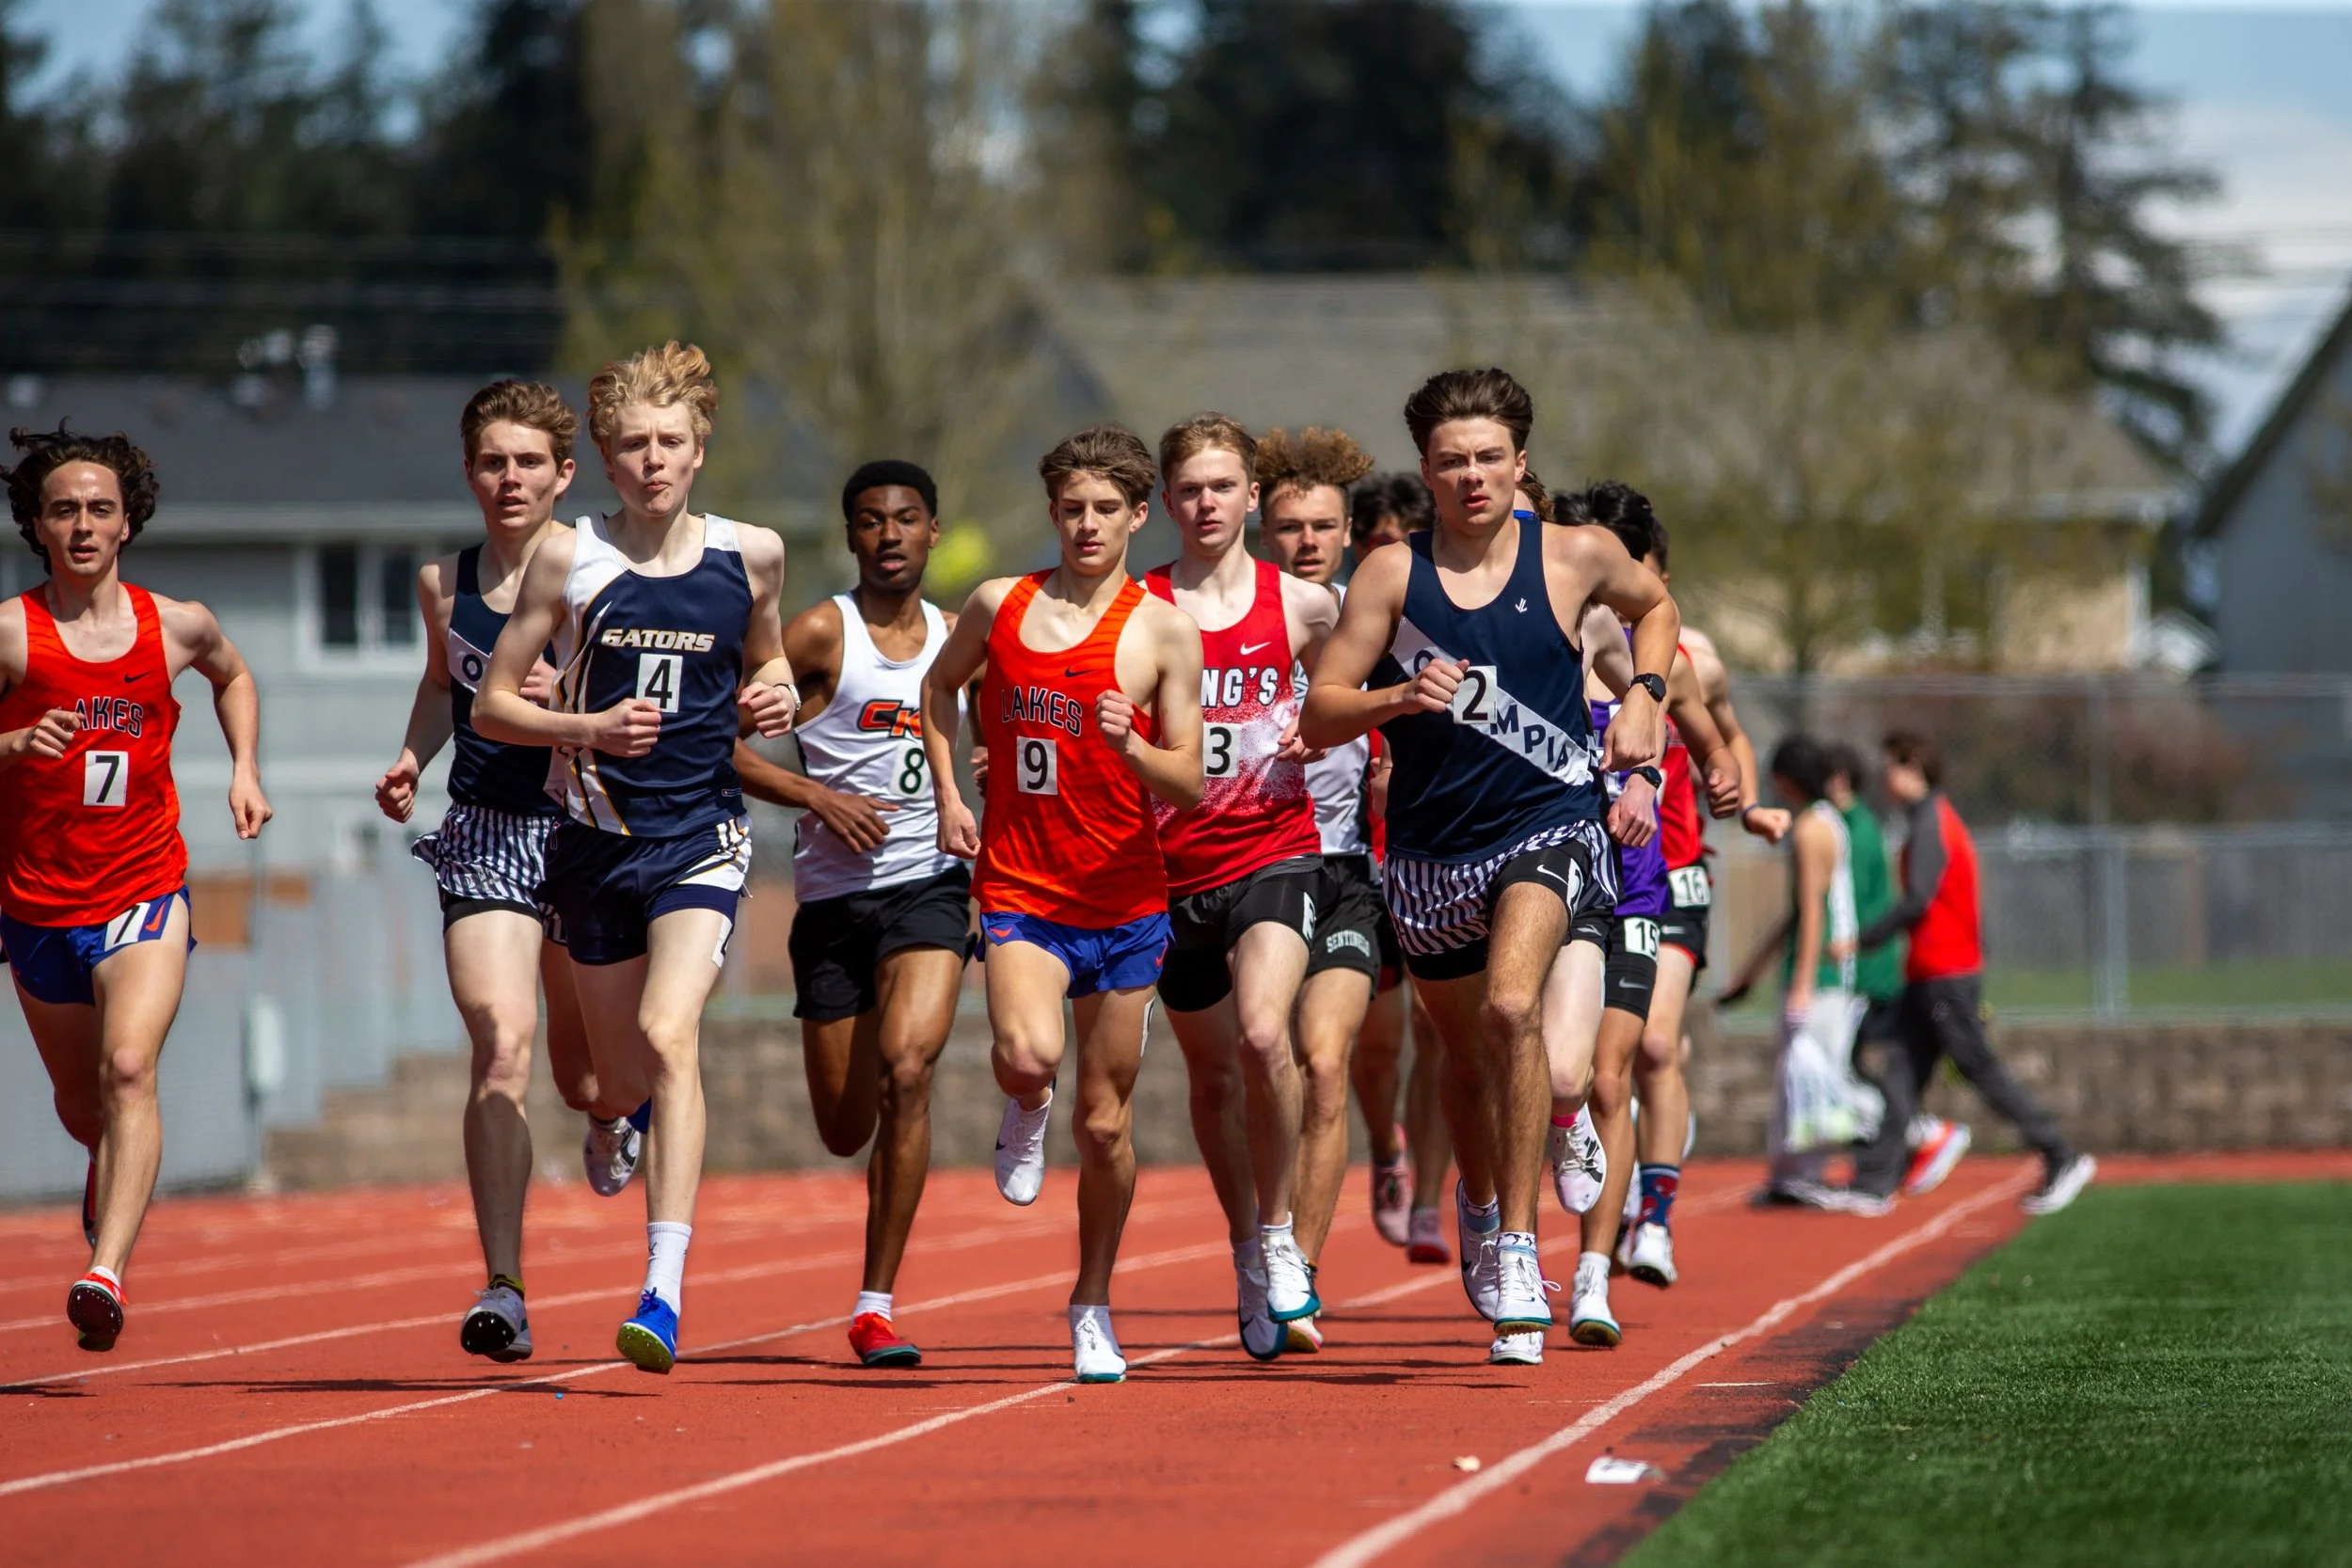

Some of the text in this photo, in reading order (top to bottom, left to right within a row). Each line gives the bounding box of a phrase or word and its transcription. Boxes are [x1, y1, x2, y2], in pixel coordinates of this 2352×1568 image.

[600, 628, 716, 653] GATORS
[644, 658, 673, 708] 4
[1201, 666, 1279, 708] NG'S
[1462, 670, 1488, 721] 2
[70, 696, 144, 738] AKES
[1001, 685, 1083, 737] LAKES
[1413, 649, 1569, 772] OMPIA
[898, 747, 926, 795] 8
[1024, 740, 1049, 791] 9
[1205, 726, 1232, 776] 3
[95, 754, 119, 803] 7
[1679, 871, 1705, 902] 16
[114, 904, 141, 945] 7
